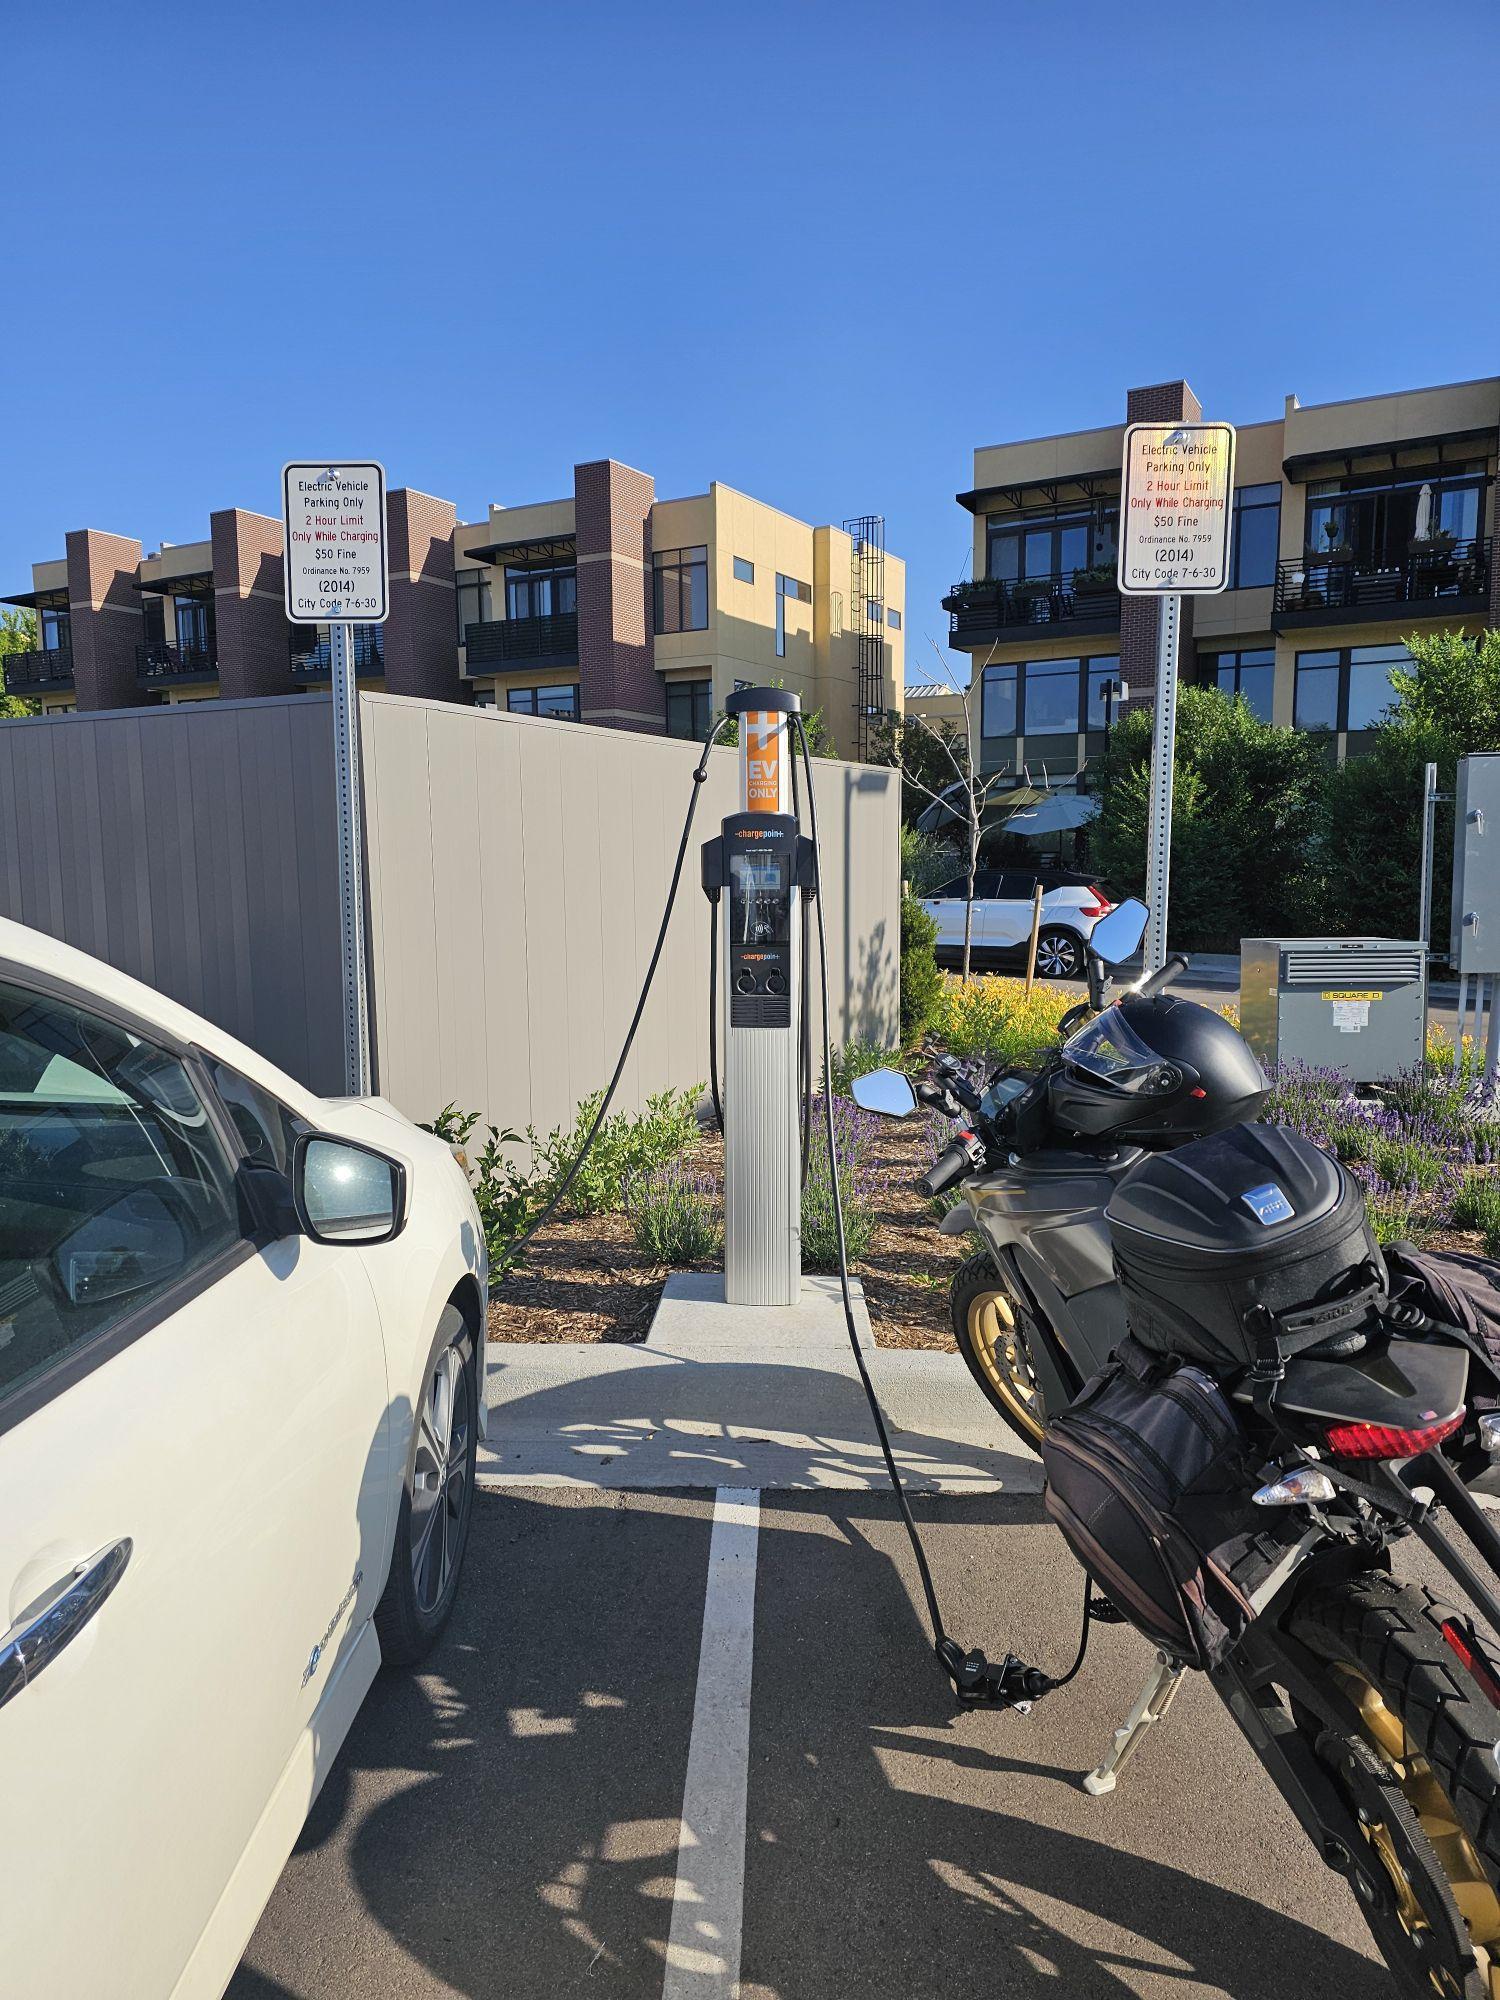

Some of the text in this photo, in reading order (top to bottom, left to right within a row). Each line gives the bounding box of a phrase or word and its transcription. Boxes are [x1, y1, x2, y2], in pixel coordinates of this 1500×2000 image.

[1142, 445, 1217, 455] Electric Vehicle
[1146, 462, 1210, 474] Parking Only
[299, 481, 368, 491] Electric Vehicle
[1147, 481, 1208, 491] 2 Hour Limit
[304, 497, 363, 509] Parking Only
[1131, 497, 1224, 510] Only While Charging
[306, 515, 363, 525] 2 Hour Limit
[1154, 516, 1198, 527] $50 Fine
[292, 531, 378, 543] Only While Charging
[315, 549, 356, 559] $50 Fine
[1155, 549, 1194, 562] (2014)
[1132, 568, 1216, 581] City Code 7-6-30
[319, 581, 355, 592] (2014)
[298, 599, 376, 610] City Code 7-6-30
[749, 760, 778, 779] EV
[749, 788, 778, 798] ONLY
